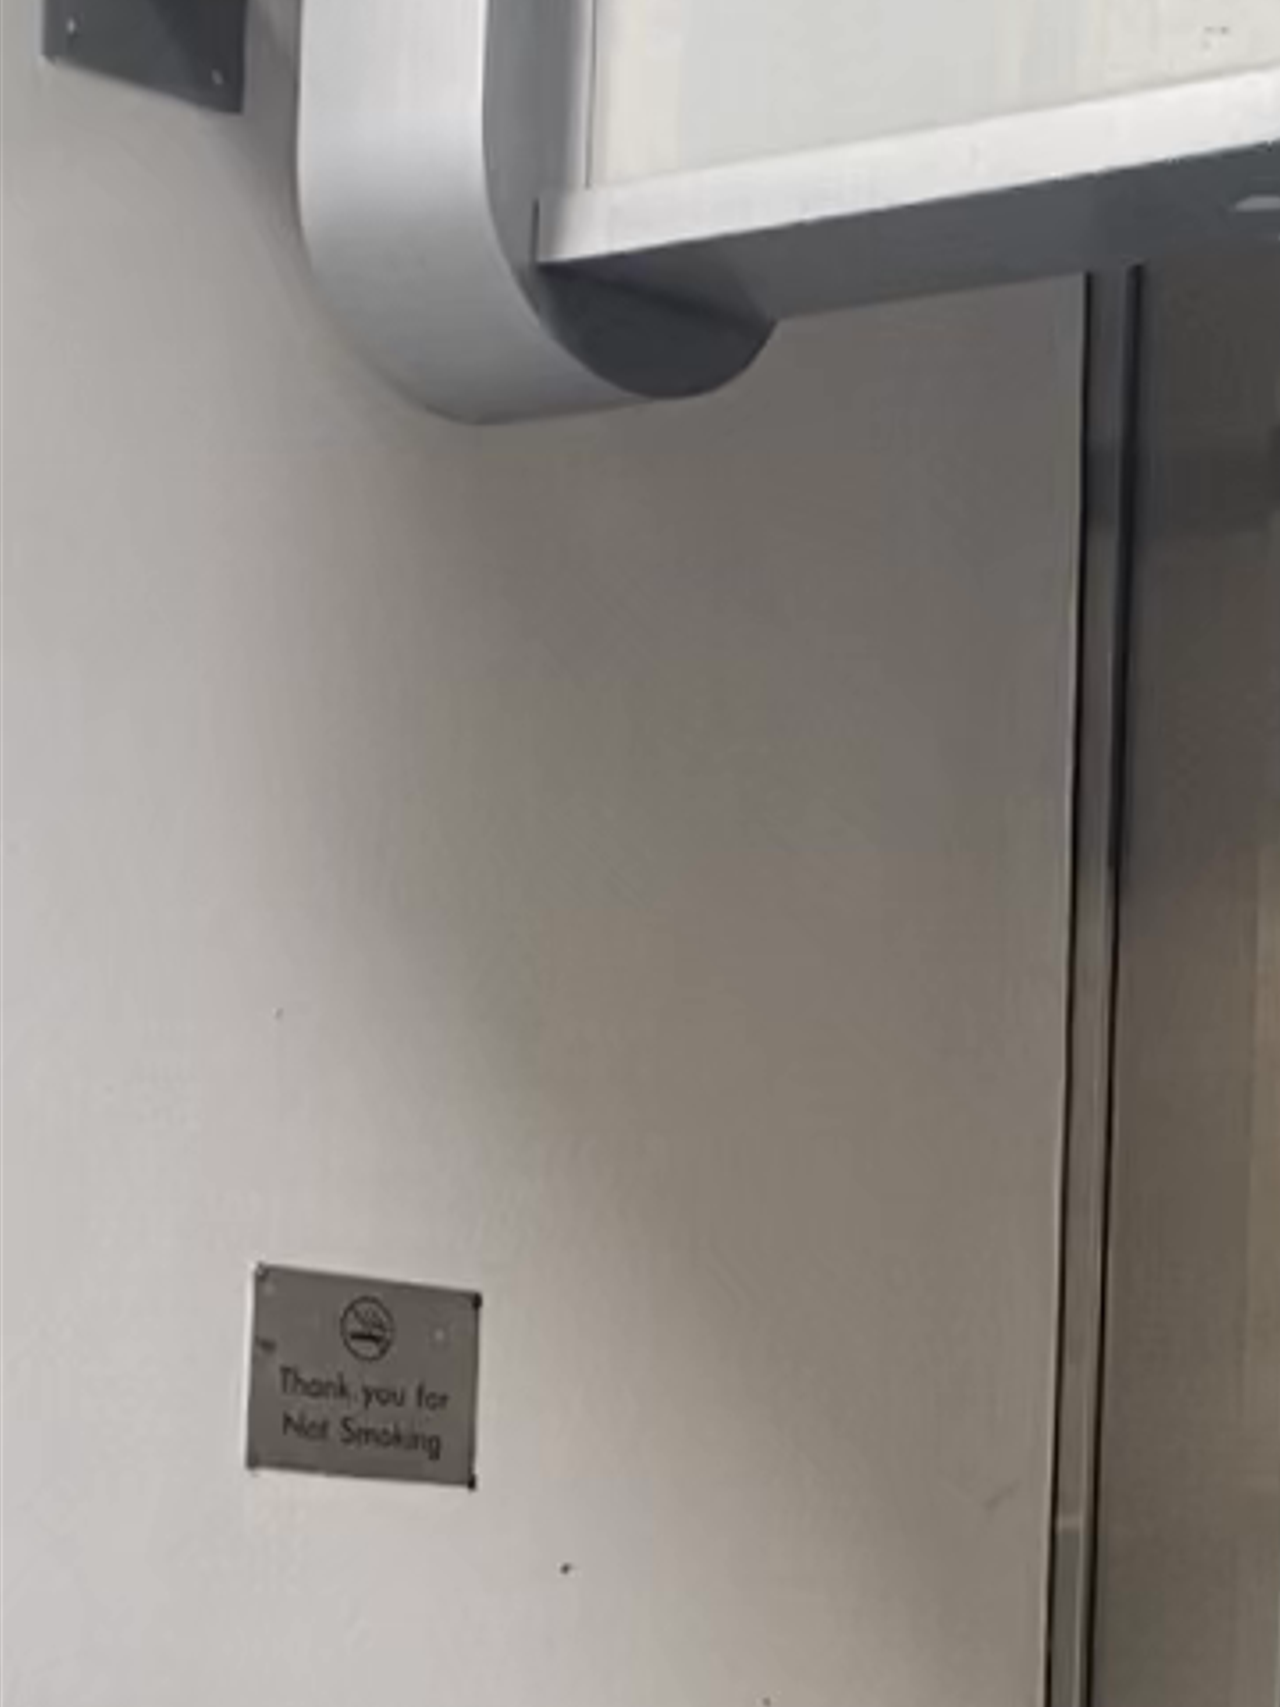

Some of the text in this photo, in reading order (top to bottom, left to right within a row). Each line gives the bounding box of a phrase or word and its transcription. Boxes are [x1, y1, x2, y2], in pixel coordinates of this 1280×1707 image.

[279, 1365, 450, 1411] Thank you for
[282, 1411, 442, 1461] Not Smoking
